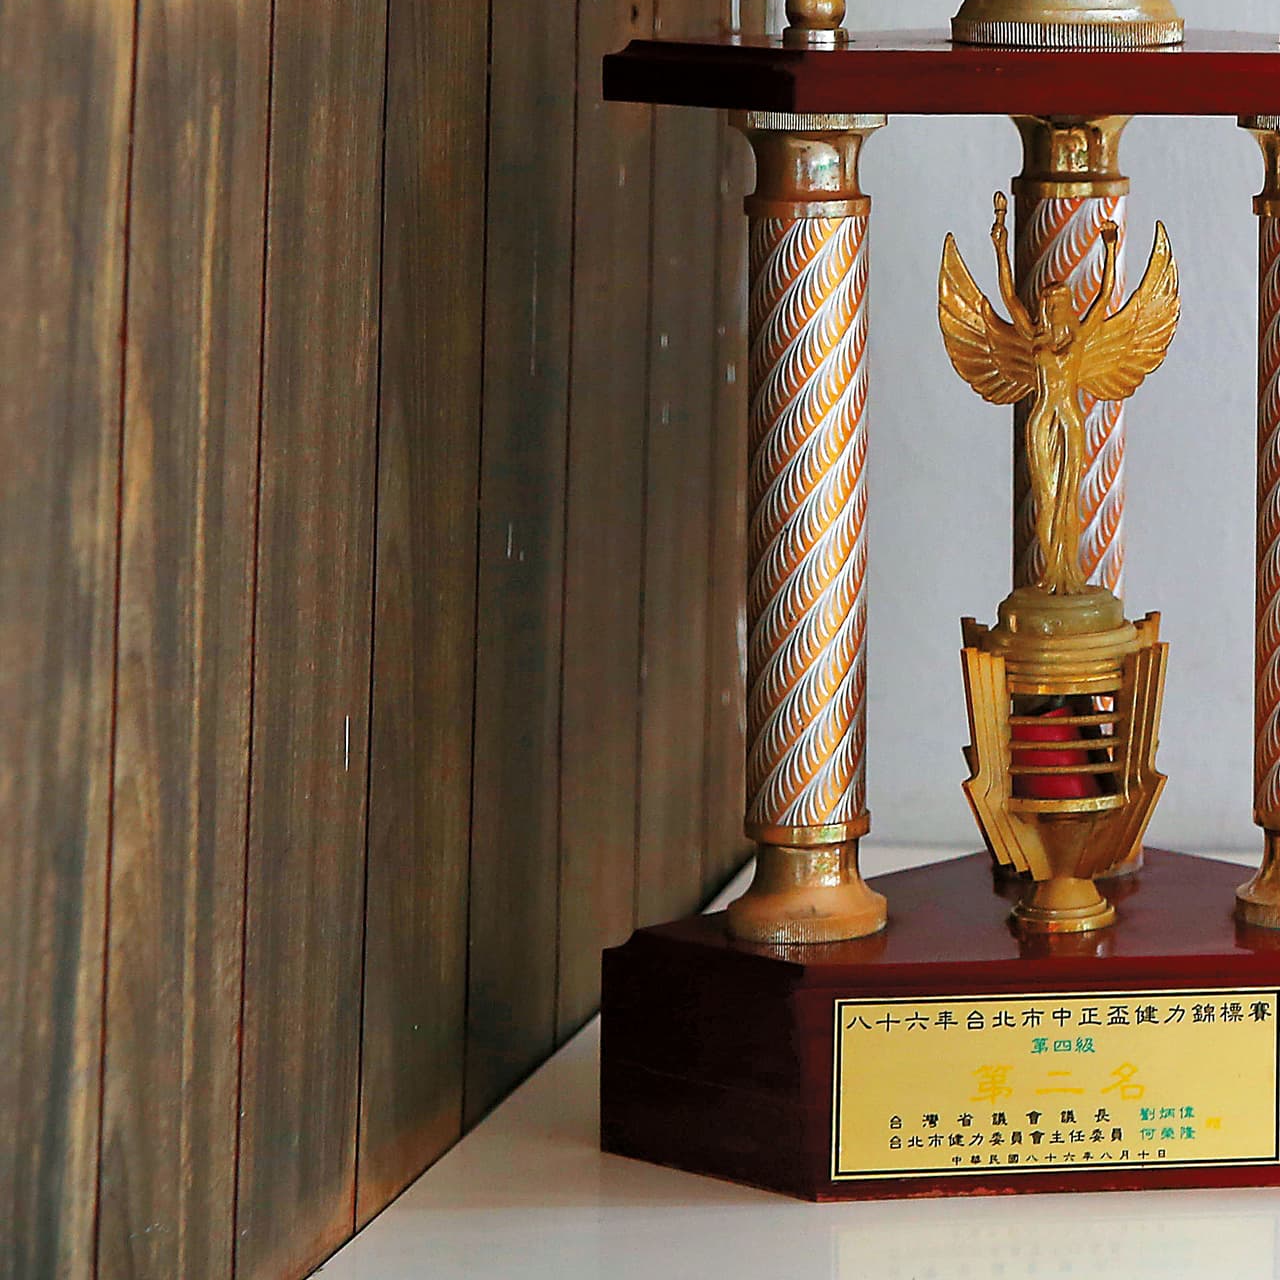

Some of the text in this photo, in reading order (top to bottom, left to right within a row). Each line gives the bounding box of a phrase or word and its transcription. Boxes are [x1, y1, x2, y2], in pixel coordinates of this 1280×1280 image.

[845, 1000, 1273, 1032] 八十六年台北市中正盃健力錦標賽
[1030, 1037, 1096, 1055] 第四級
[969, 1062, 1146, 1105] 第二名
[889, 1109, 1111, 1130] 台灣省議會議長
[889, 1127, 1124, 1150] 台北市健力委員會主任委員
[951, 1149, 1167, 1166] 中華民國八十六年八月十日
